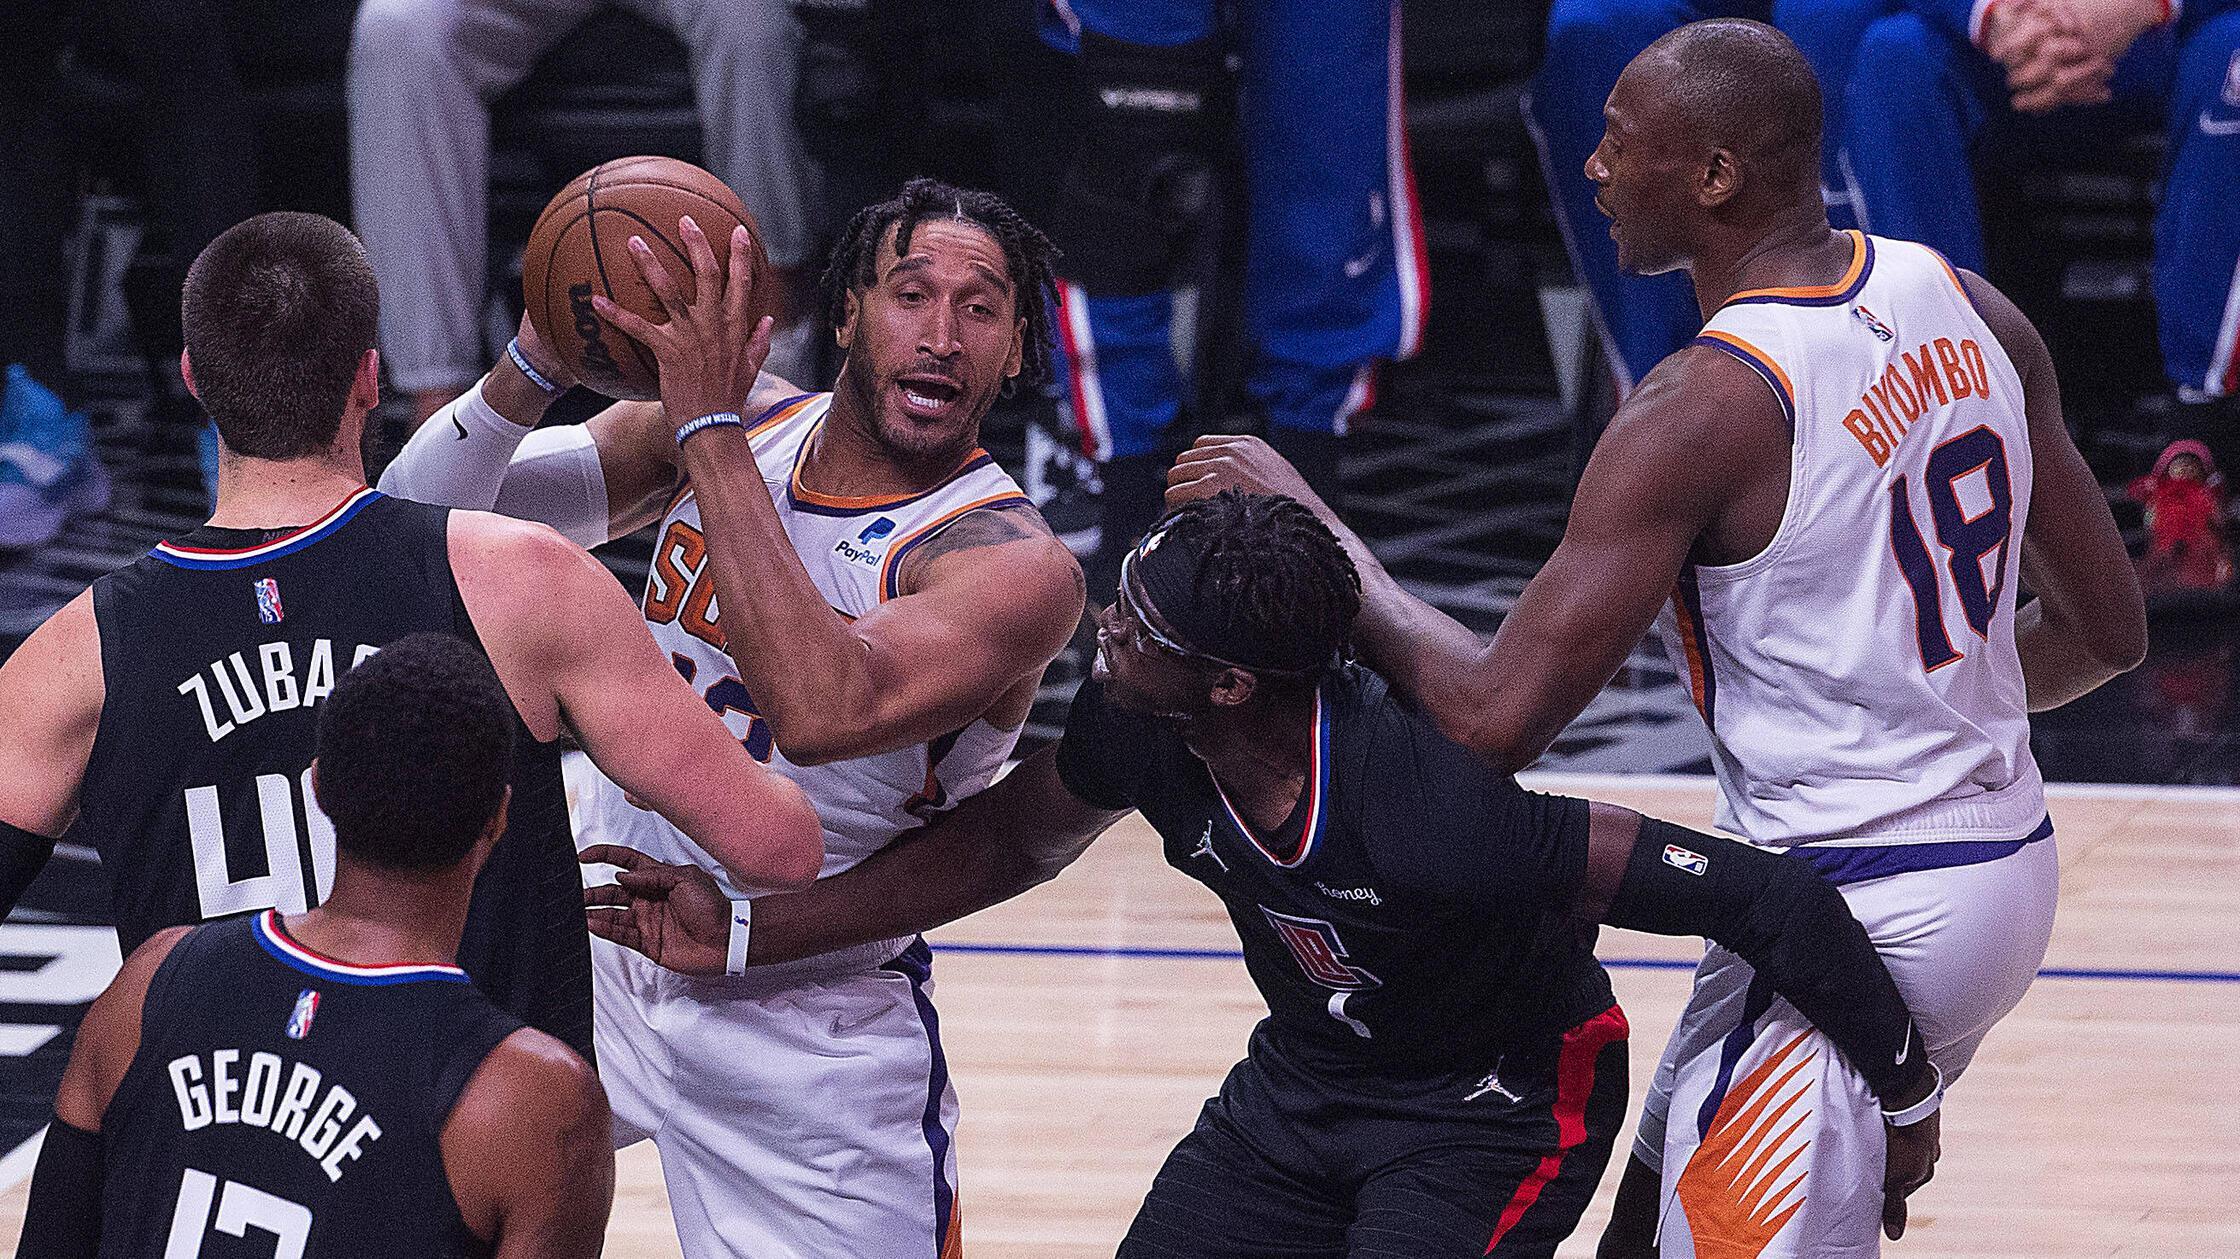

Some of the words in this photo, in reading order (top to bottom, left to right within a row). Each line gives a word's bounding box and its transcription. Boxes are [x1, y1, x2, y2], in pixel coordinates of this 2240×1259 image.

[1842, 337, 1990, 469] BIYOMBO
[834, 540, 882, 567] PayPal
[1887, 424, 2013, 672] 18
[168, 1049, 383, 1183] GEORGE
